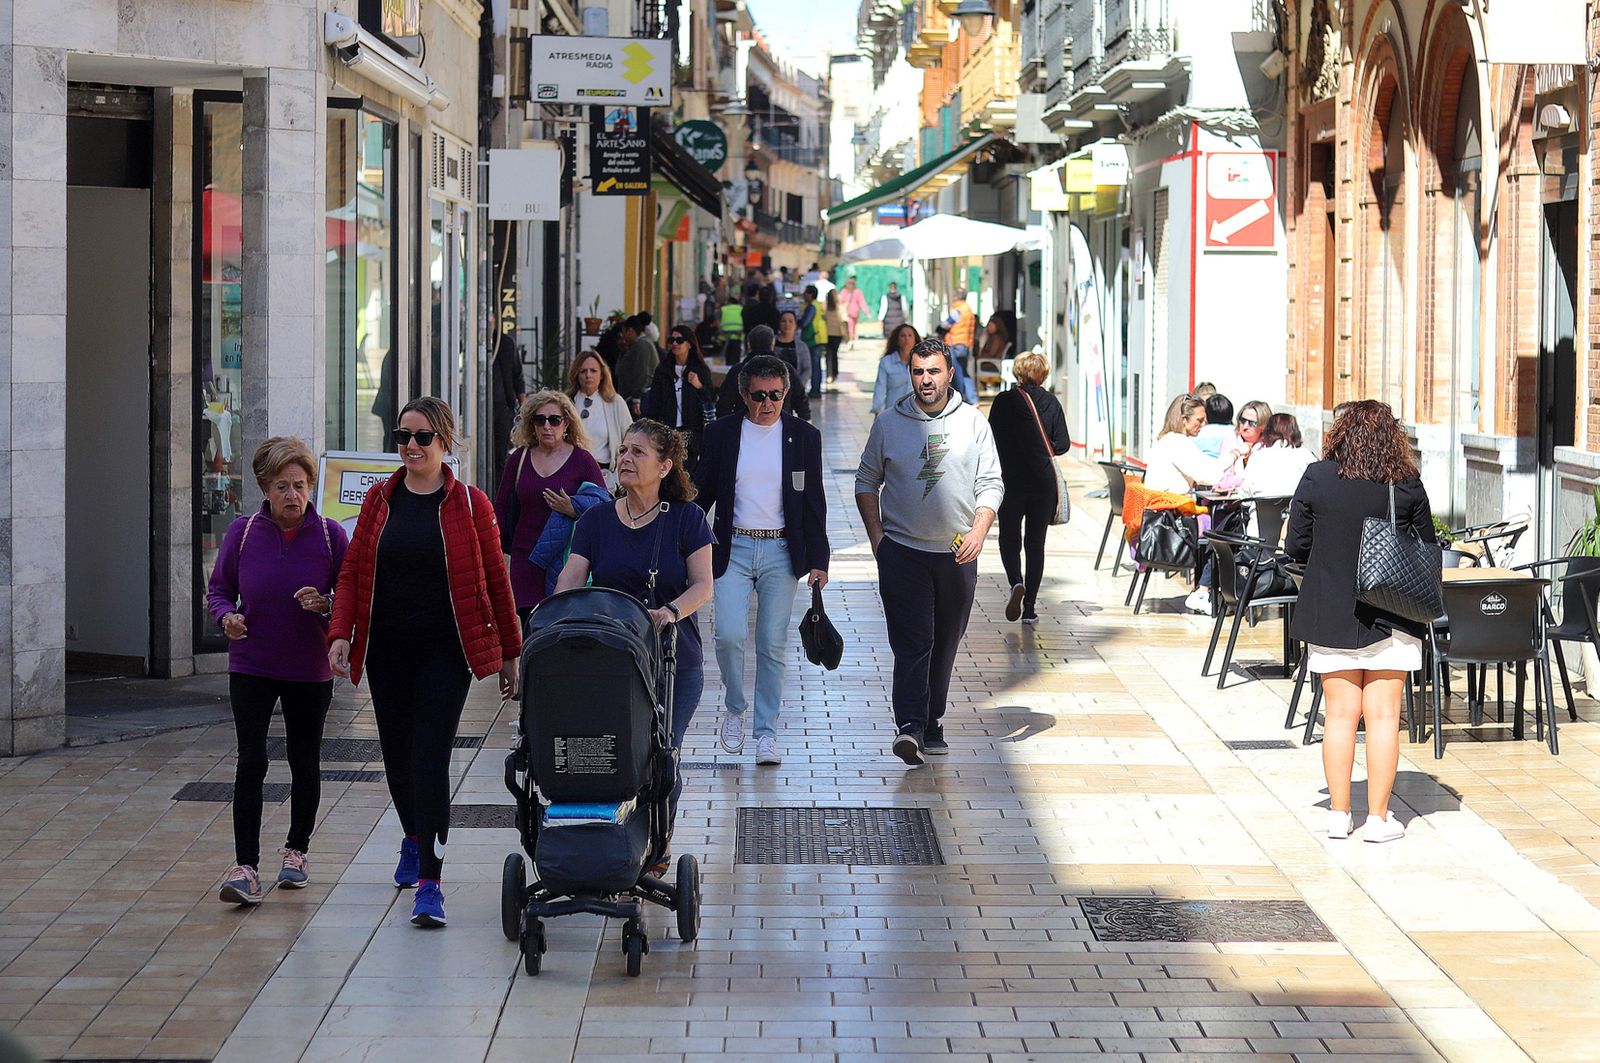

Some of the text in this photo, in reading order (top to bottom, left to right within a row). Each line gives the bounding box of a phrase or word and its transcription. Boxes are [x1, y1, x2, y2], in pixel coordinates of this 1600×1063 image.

[548, 52, 613, 60] ATRESMEDIA
[585, 61, 614, 69] RADIO
[596, 132, 607, 140] EL
